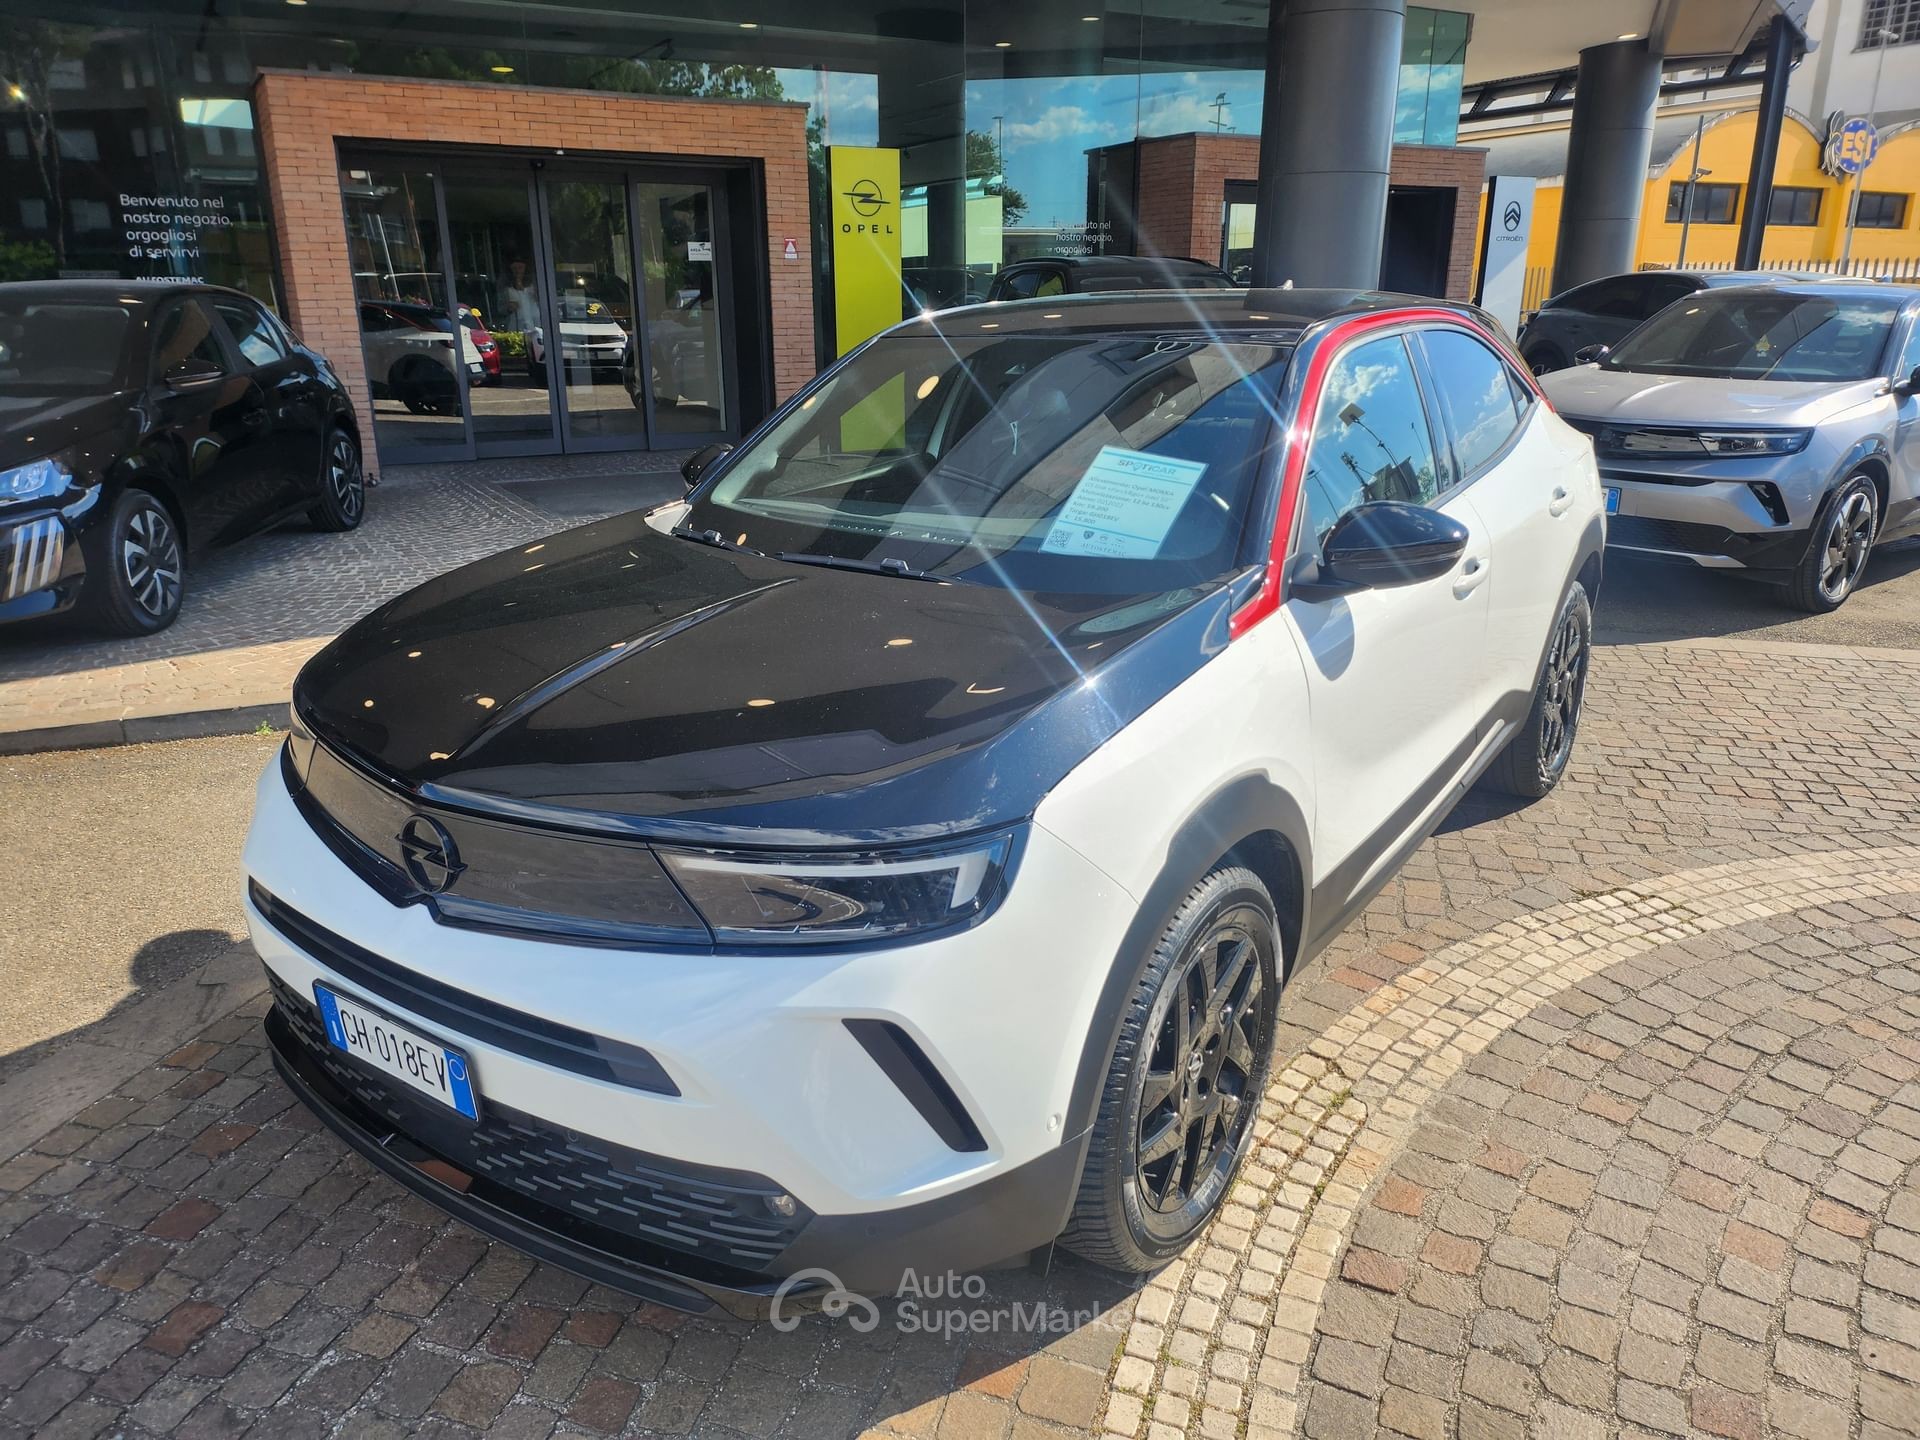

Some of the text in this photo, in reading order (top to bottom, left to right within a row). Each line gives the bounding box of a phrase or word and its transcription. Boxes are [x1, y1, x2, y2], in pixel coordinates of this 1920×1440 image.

[119, 193, 224, 209] Benvenuto nel
[123, 212, 234, 228] nostro negozio,
[1099, 220, 1111, 230] nel
[126, 228, 197, 243] orgogliosi
[842, 223, 893, 234] OPEL
[1055, 233, 1081, 242] nostro
[129, 245, 200, 259] di servirvi
